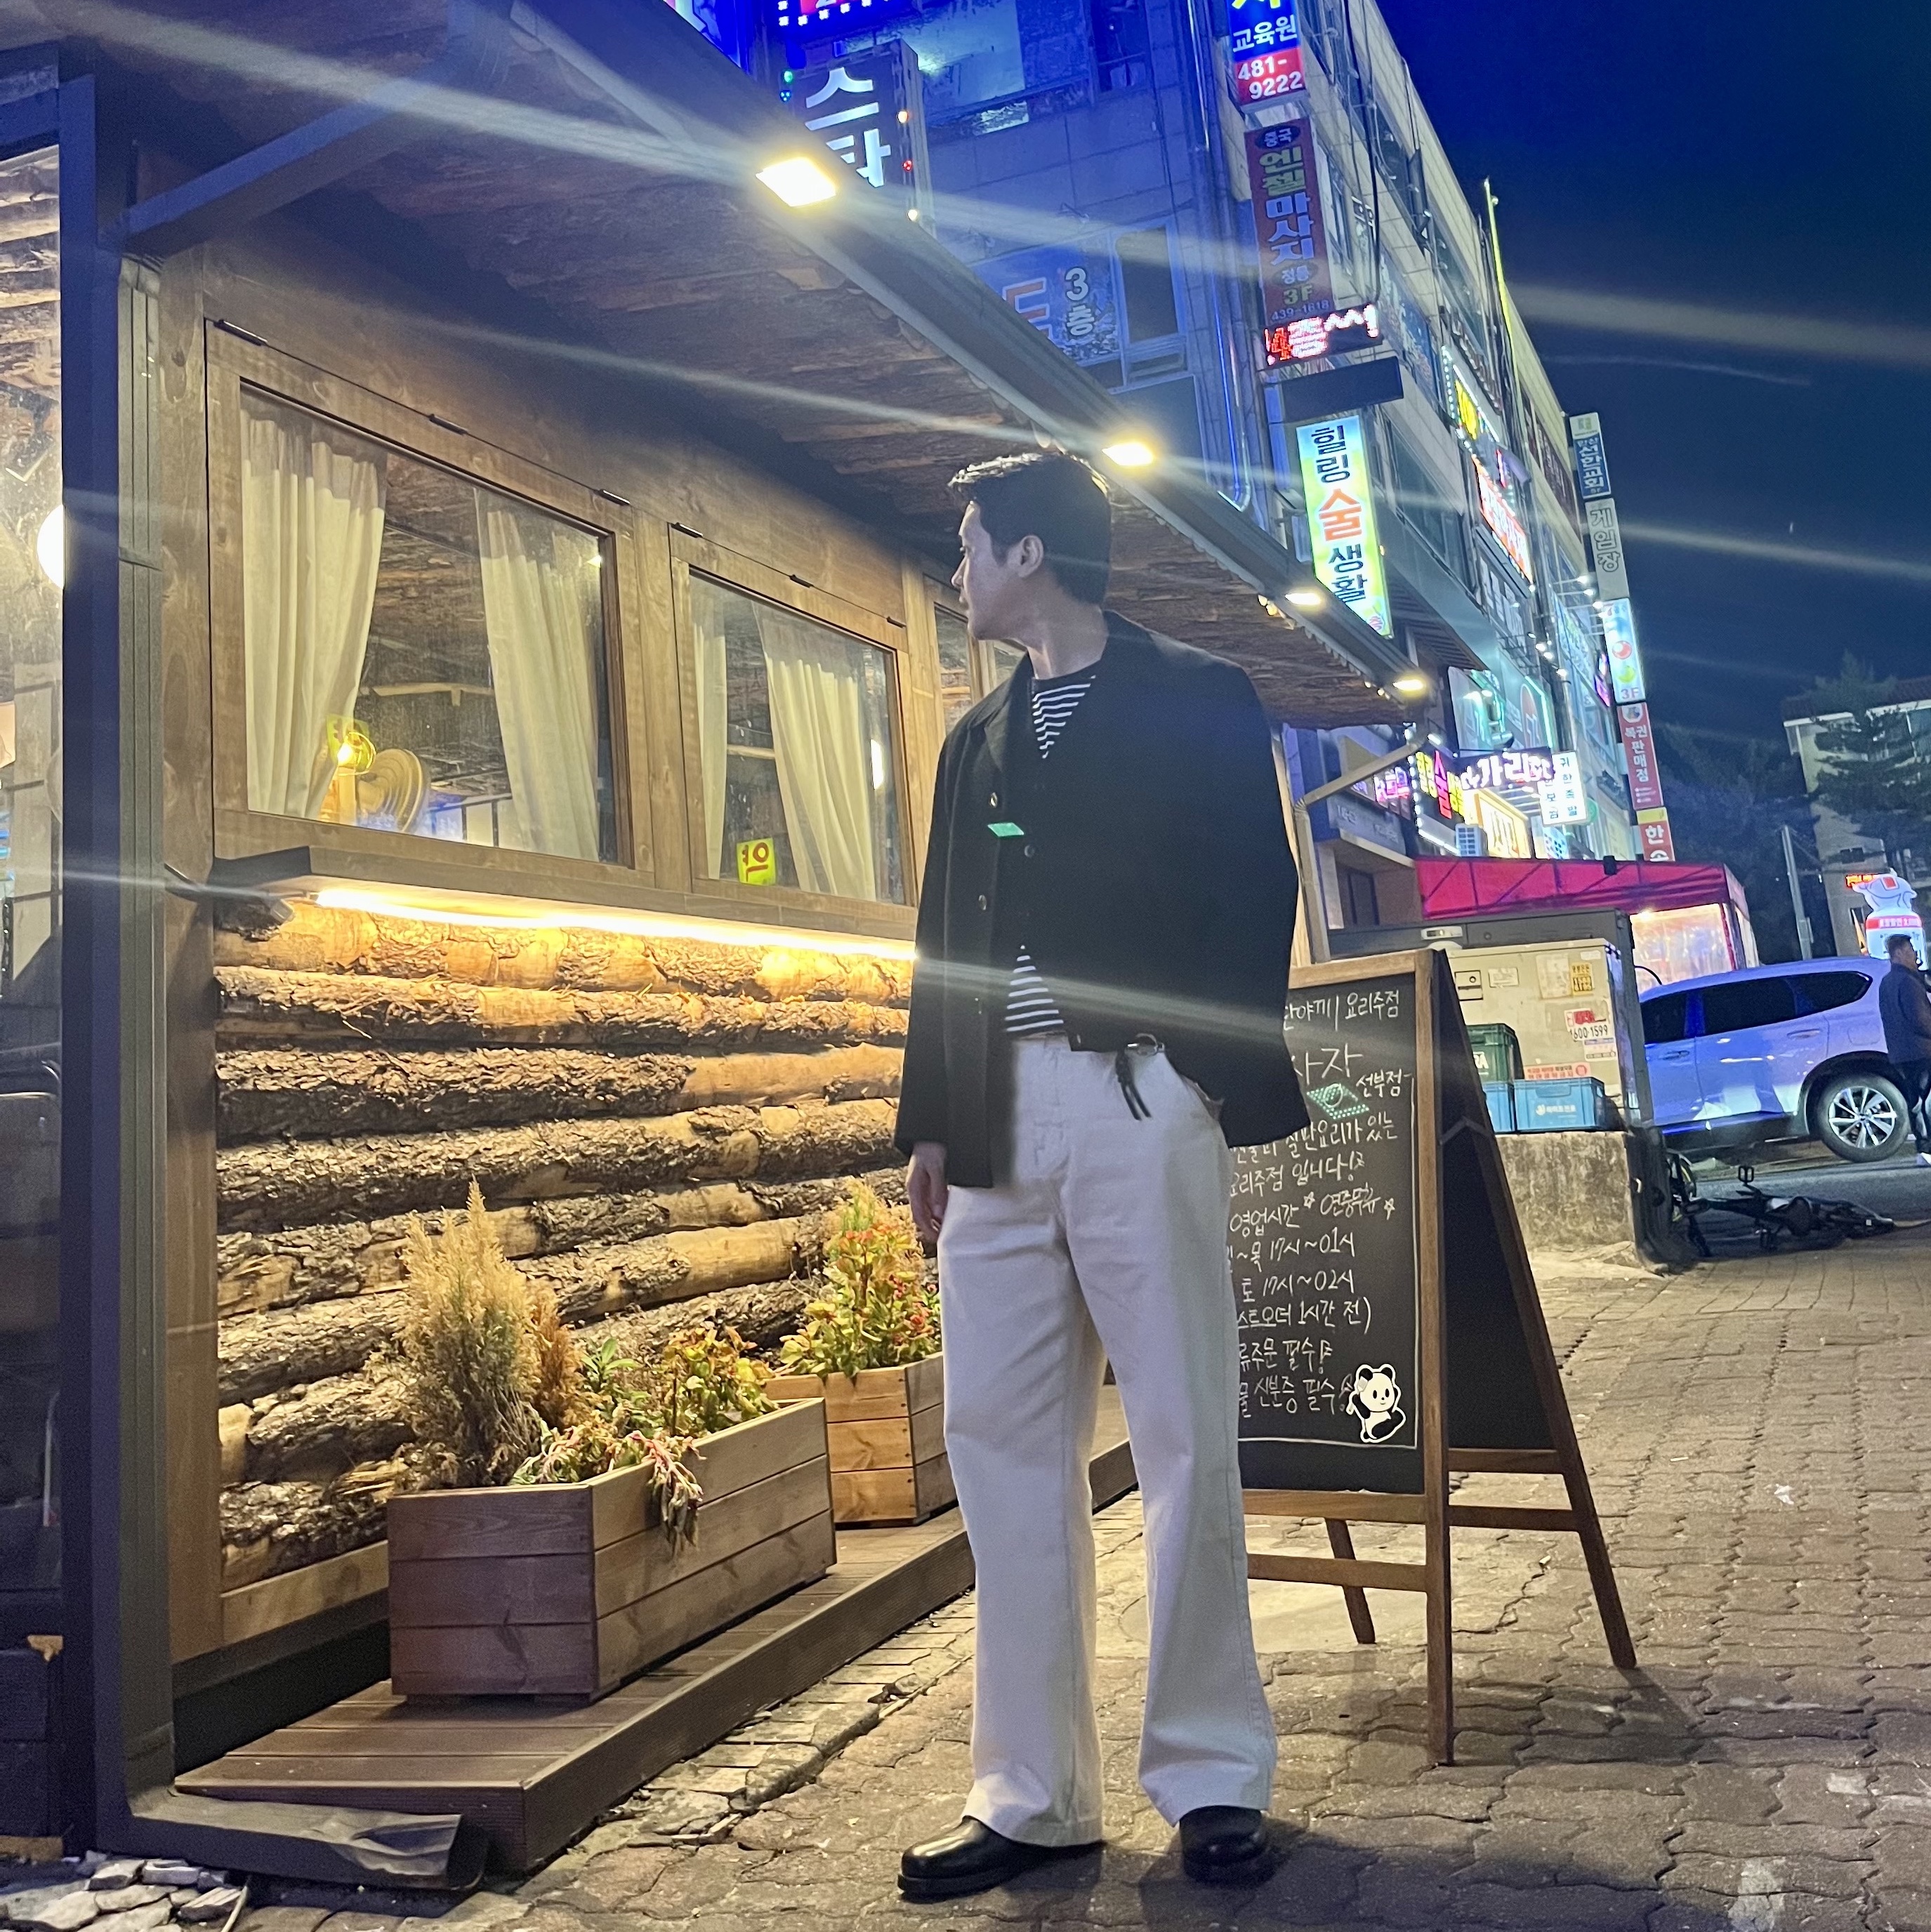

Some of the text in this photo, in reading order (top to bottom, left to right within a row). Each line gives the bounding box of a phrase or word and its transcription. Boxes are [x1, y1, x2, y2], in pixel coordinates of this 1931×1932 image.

[1232, 14, 1298, 53] 교육원
[1238, 55, 1287, 80] 481-
[1248, 71, 1303, 100] 9222
[1266, 191, 1314, 266] 마사지
[1065, 267, 1095, 336] 3층
[1283, 284, 1313, 305] 3F
[1311, 425, 1350, 484] 힐링
[1318, 488, 1362, 542] 술
[1590, 507, 1621, 573] 게임장
[1328, 543, 1368, 602] 생활
[1621, 687, 1640, 699] 3F
[1345, 989, 1399, 1020] 요리주점
[1355, 1068, 1403, 1098] 선부점
[1366, 1110, 1398, 1142] 있는
[1229, 1203, 1300, 1238] 영업시간
[1253, 1374, 1296, 1414] 신분증
